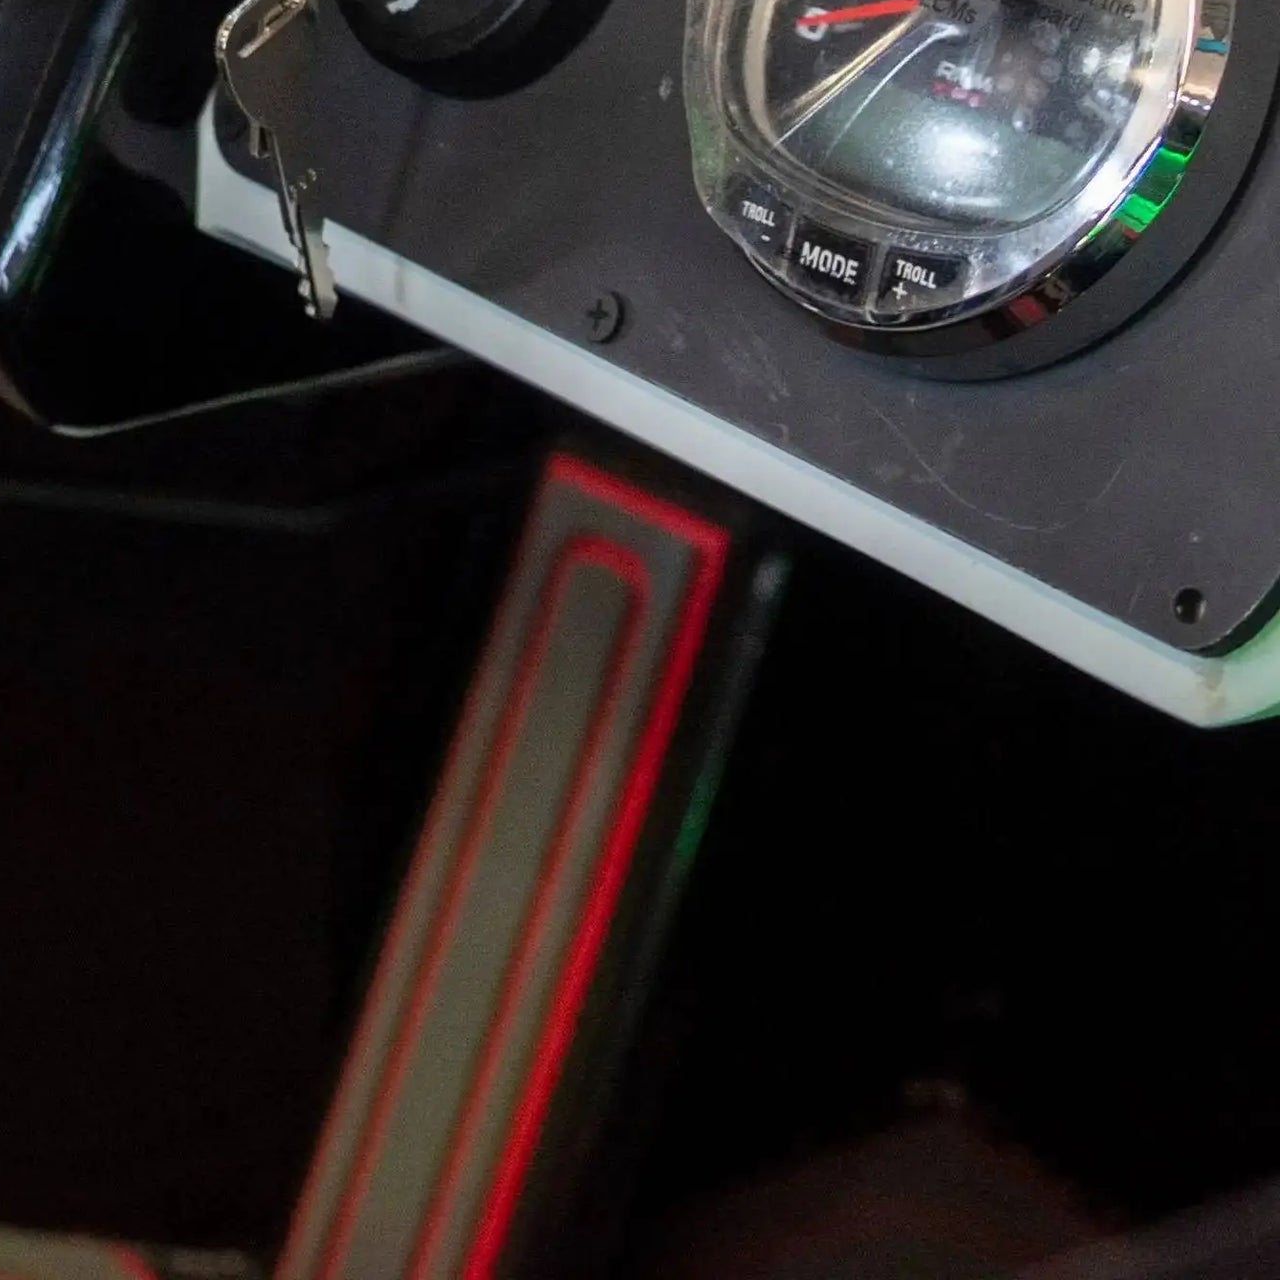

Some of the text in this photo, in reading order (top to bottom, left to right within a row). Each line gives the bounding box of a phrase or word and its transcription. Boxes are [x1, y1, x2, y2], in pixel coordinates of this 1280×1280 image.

[742, 200, 776, 227] TROLL
[800, 241, 859, 285] MODE
[896, 259, 937, 289] TROLL
